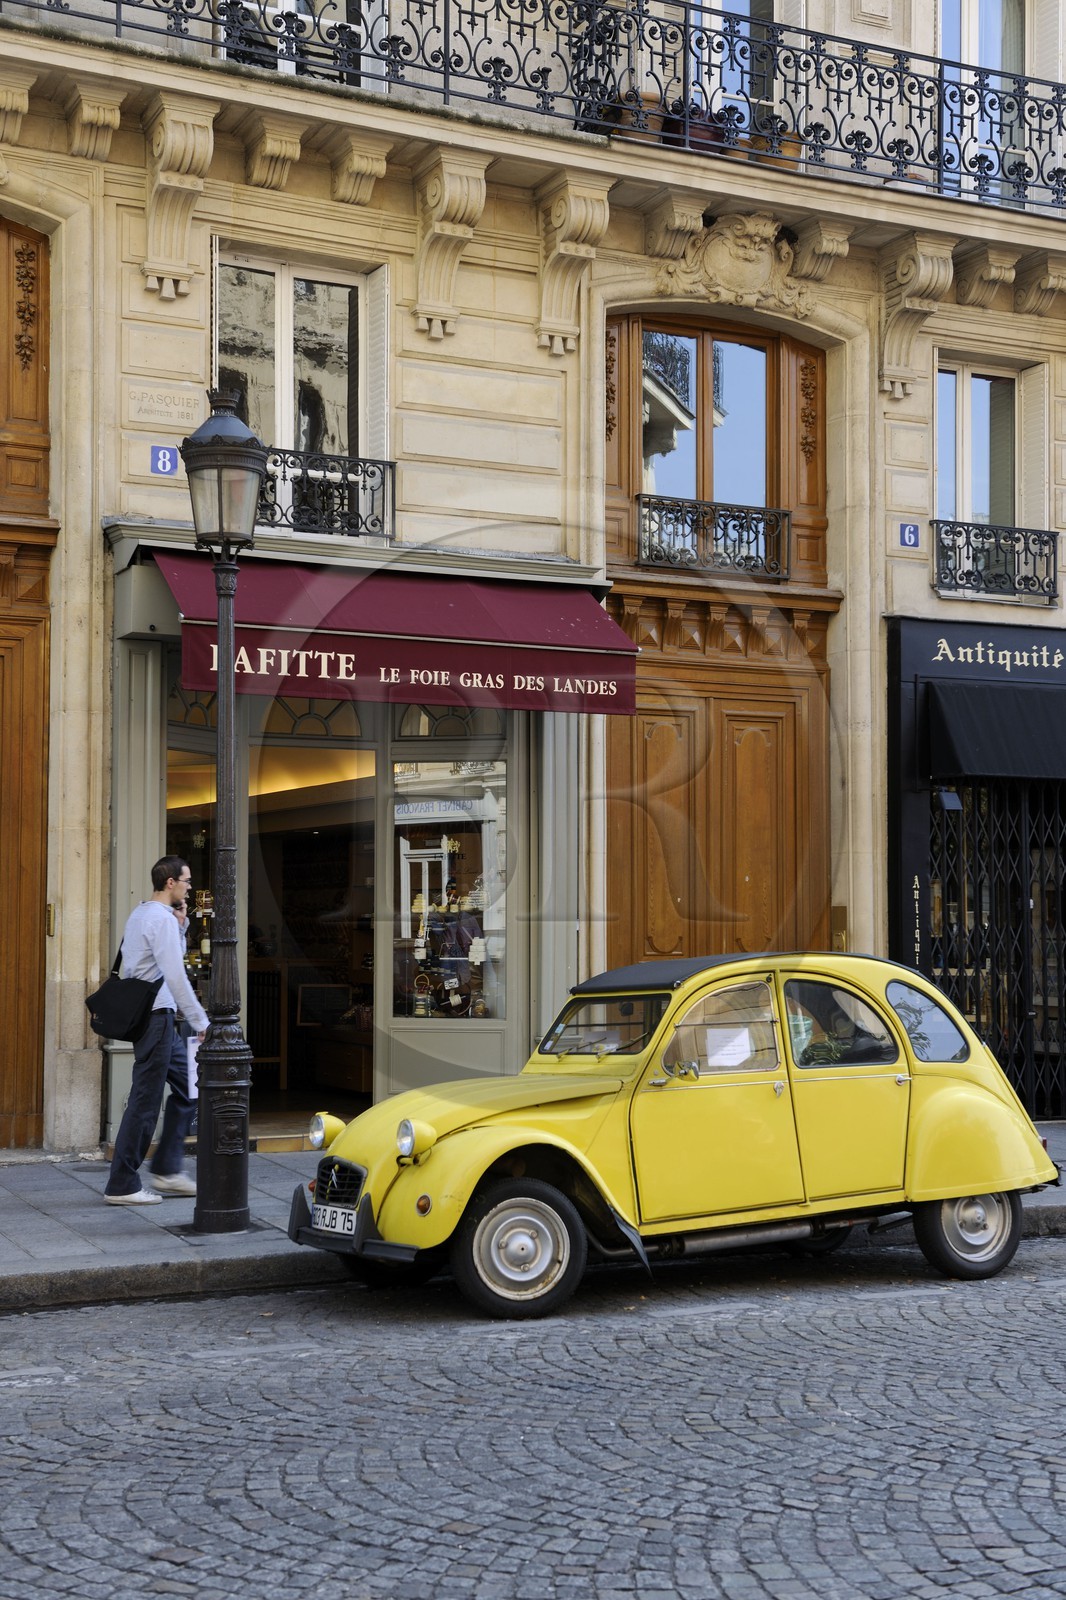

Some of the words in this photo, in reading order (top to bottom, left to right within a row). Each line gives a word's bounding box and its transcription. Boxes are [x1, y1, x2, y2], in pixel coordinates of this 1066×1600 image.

[157, 449, 171, 472] 8
[904, 525, 915, 546] 6
[931, 638, 1065, 673] Antiquité
[379, 667, 401, 683] LE
[410, 669, 451, 686] FOIE
[459, 672, 505, 689] GRAS
[513, 675, 545, 691] DES
[553, 677, 618, 695] LANDES
[341, 1211, 353, 1231] 75
